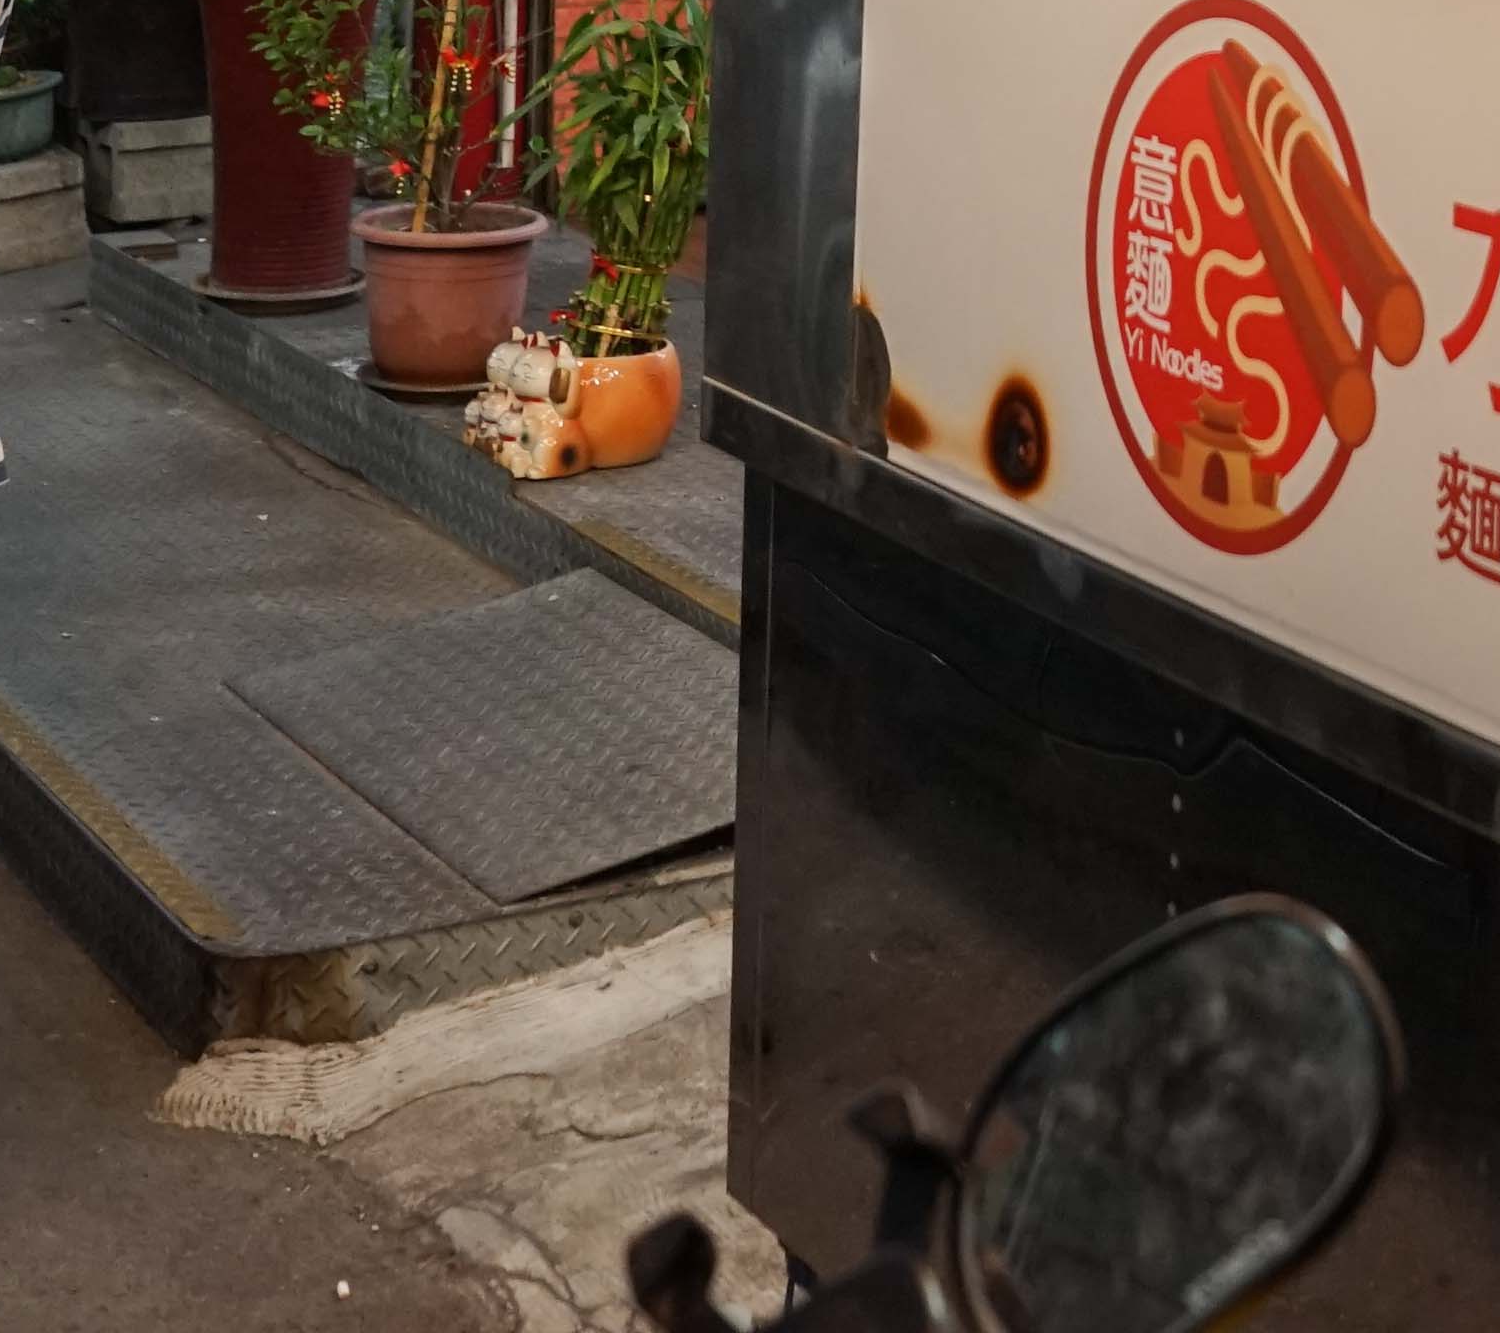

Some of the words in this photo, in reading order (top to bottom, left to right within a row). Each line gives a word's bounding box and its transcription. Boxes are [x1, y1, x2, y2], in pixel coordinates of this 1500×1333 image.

[1125, 134, 1177, 333] 意麵
[1125, 323, 1144, 361] Yi
[1151, 333, 1225, 392] Noodles
